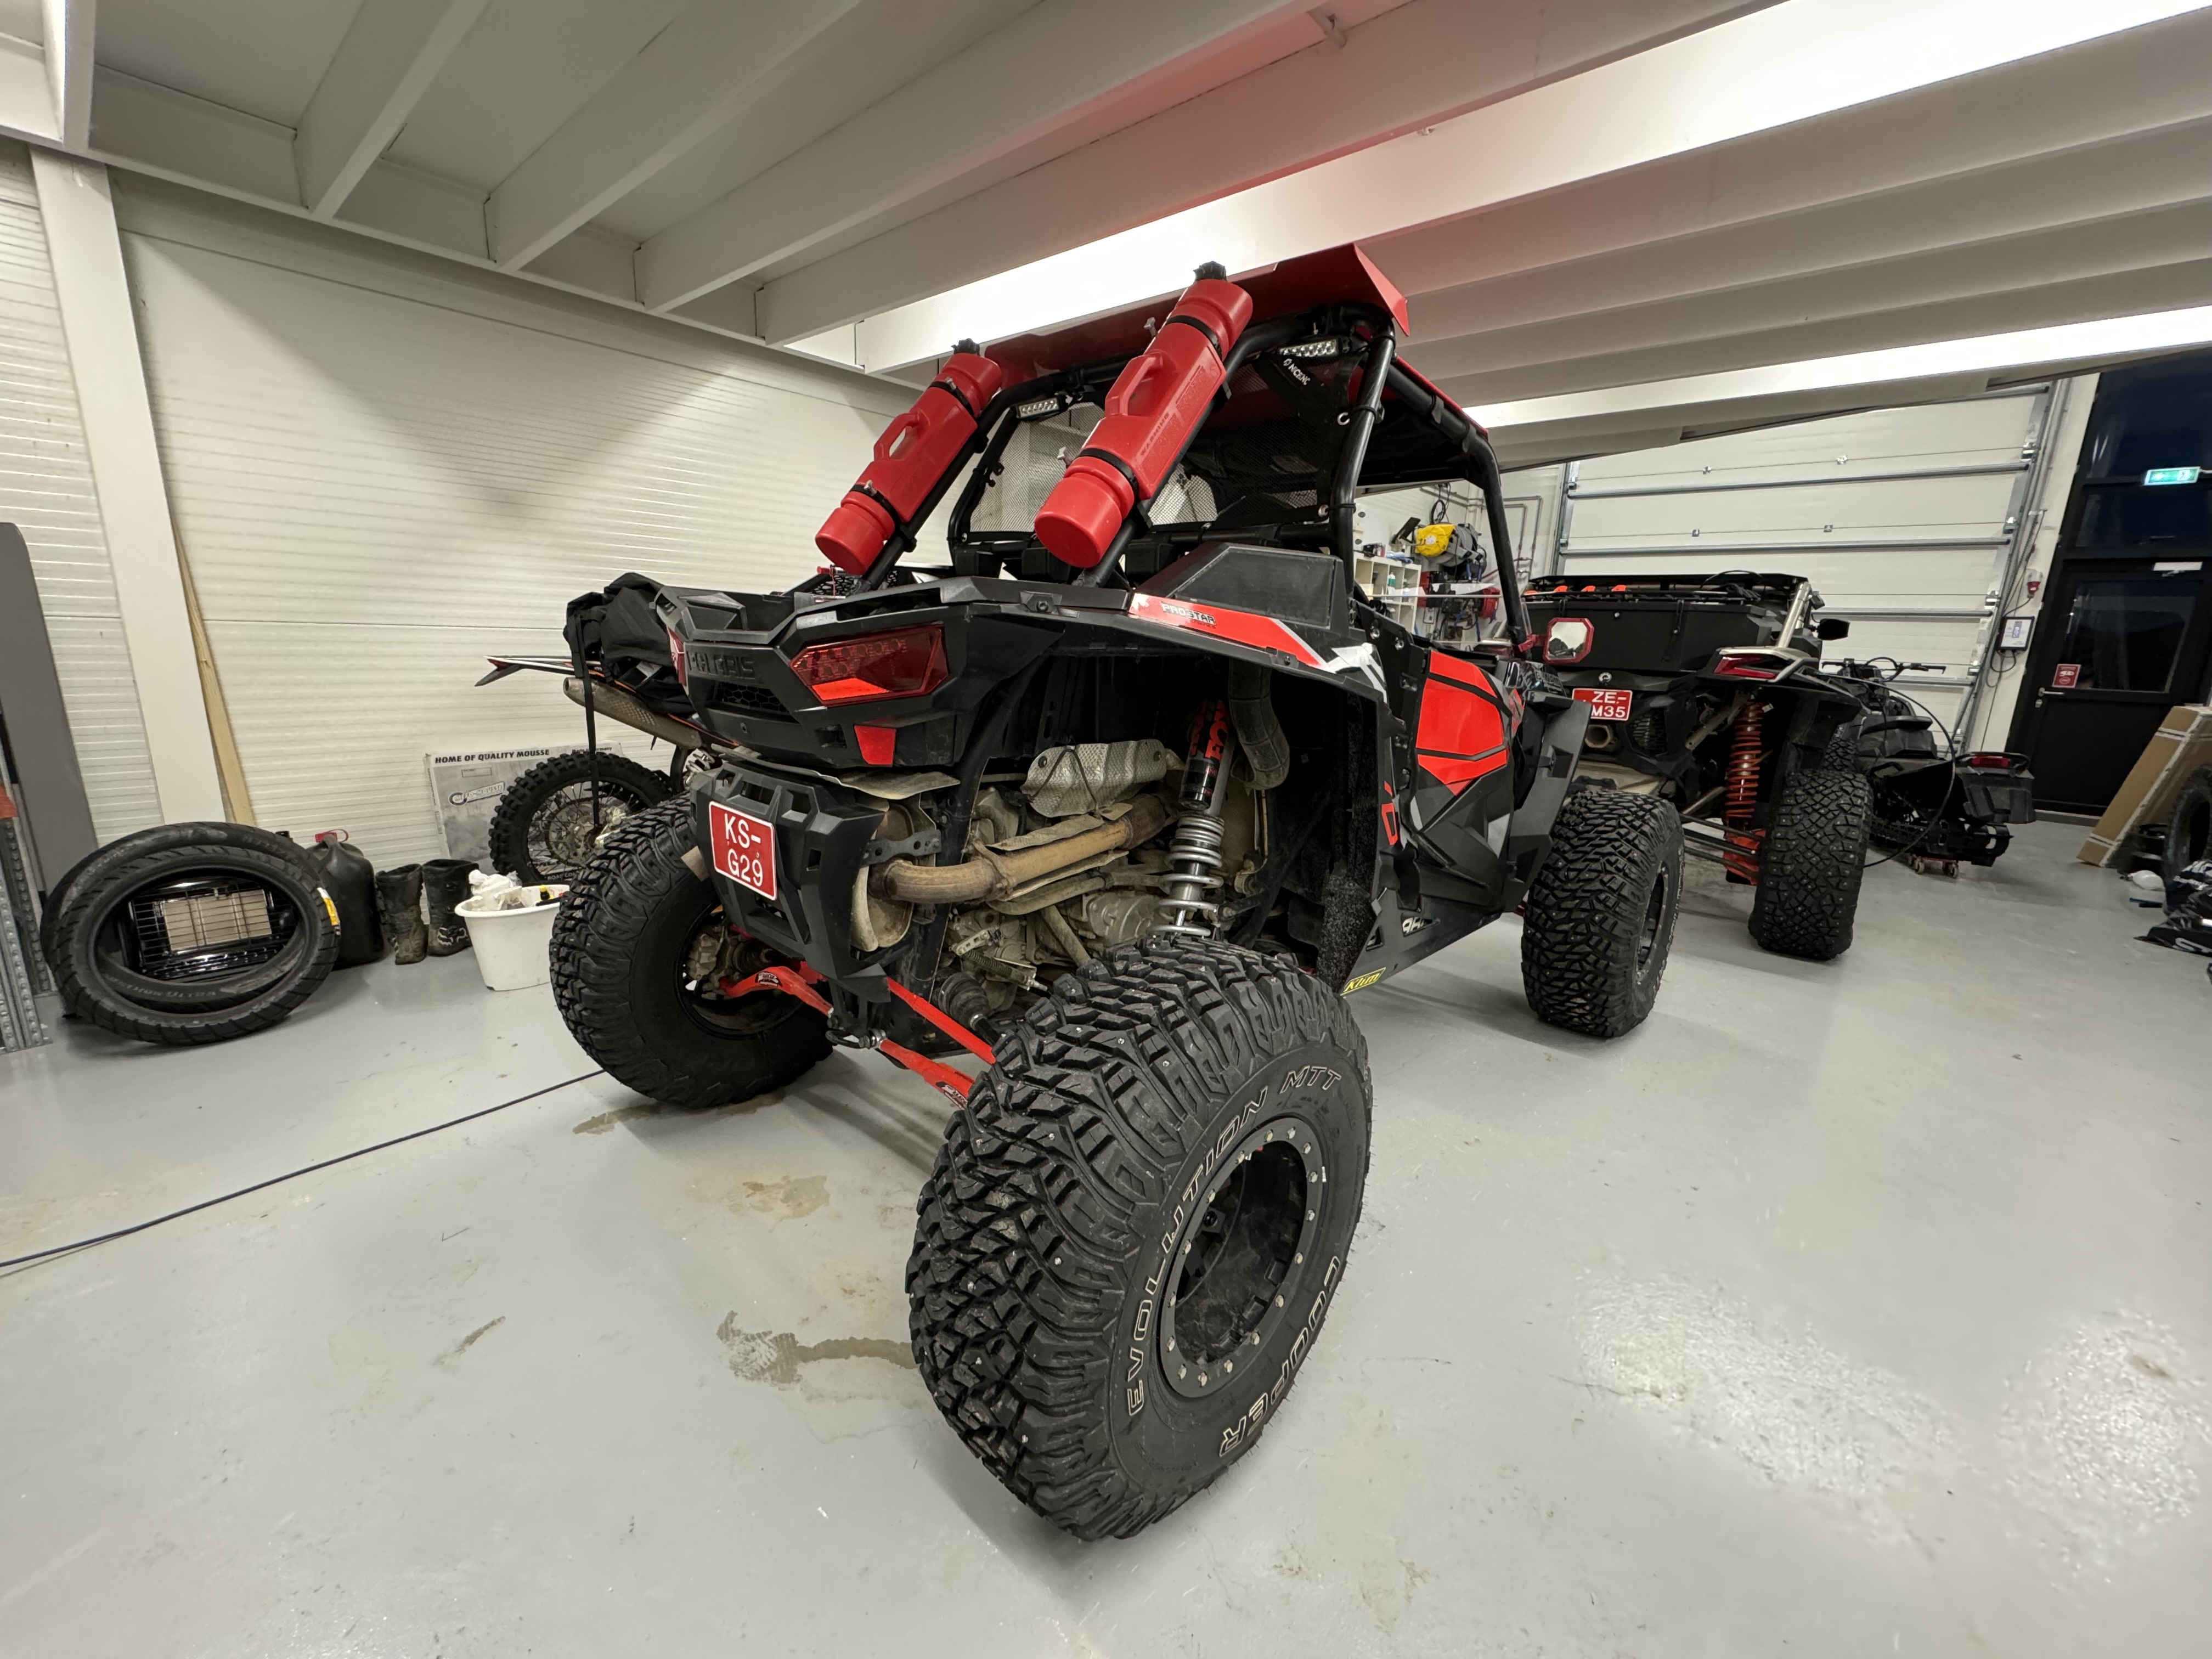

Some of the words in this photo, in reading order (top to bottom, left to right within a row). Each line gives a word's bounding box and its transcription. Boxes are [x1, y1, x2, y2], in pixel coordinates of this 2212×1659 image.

[1161, 603, 1216, 625] PROSTAR
[1591, 705, 1626, 718] M35
[1592, 691, 1627, 704] ZE-
[435, 755, 462, 764] HOME
[478, 751, 515, 761] QUALITY
[516, 749, 550, 758] MOUSSE
[725, 813, 761, 849] KS-
[727, 848, 763, 887] G29
[1127, 1086, 1268, 1417] EVOLUTION
[1280, 1065, 1341, 1094] MTT
[1219, 1255, 1341, 1457] COOPER
